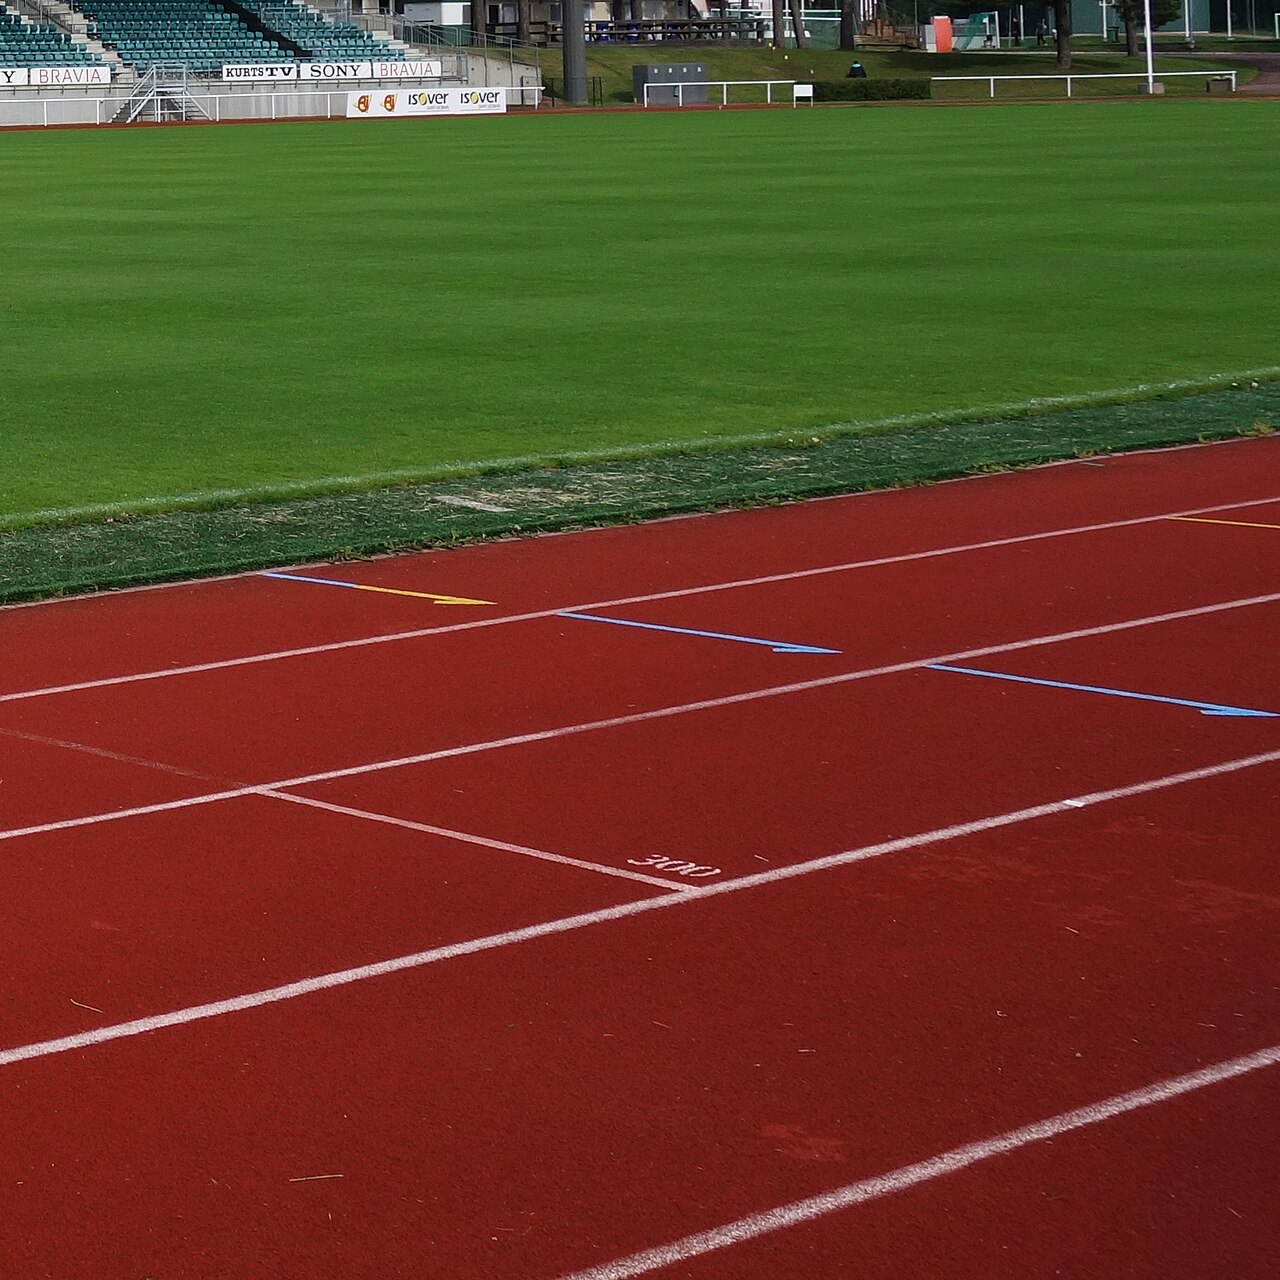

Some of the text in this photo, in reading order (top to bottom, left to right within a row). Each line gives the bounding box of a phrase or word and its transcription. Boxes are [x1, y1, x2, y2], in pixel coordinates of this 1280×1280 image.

[39, 68, 102, 83] BRAVIA
[226, 66, 294, 77] KURTS TV
[310, 64, 362, 78] SONY
[380, 62, 434, 76] BRAVIA
